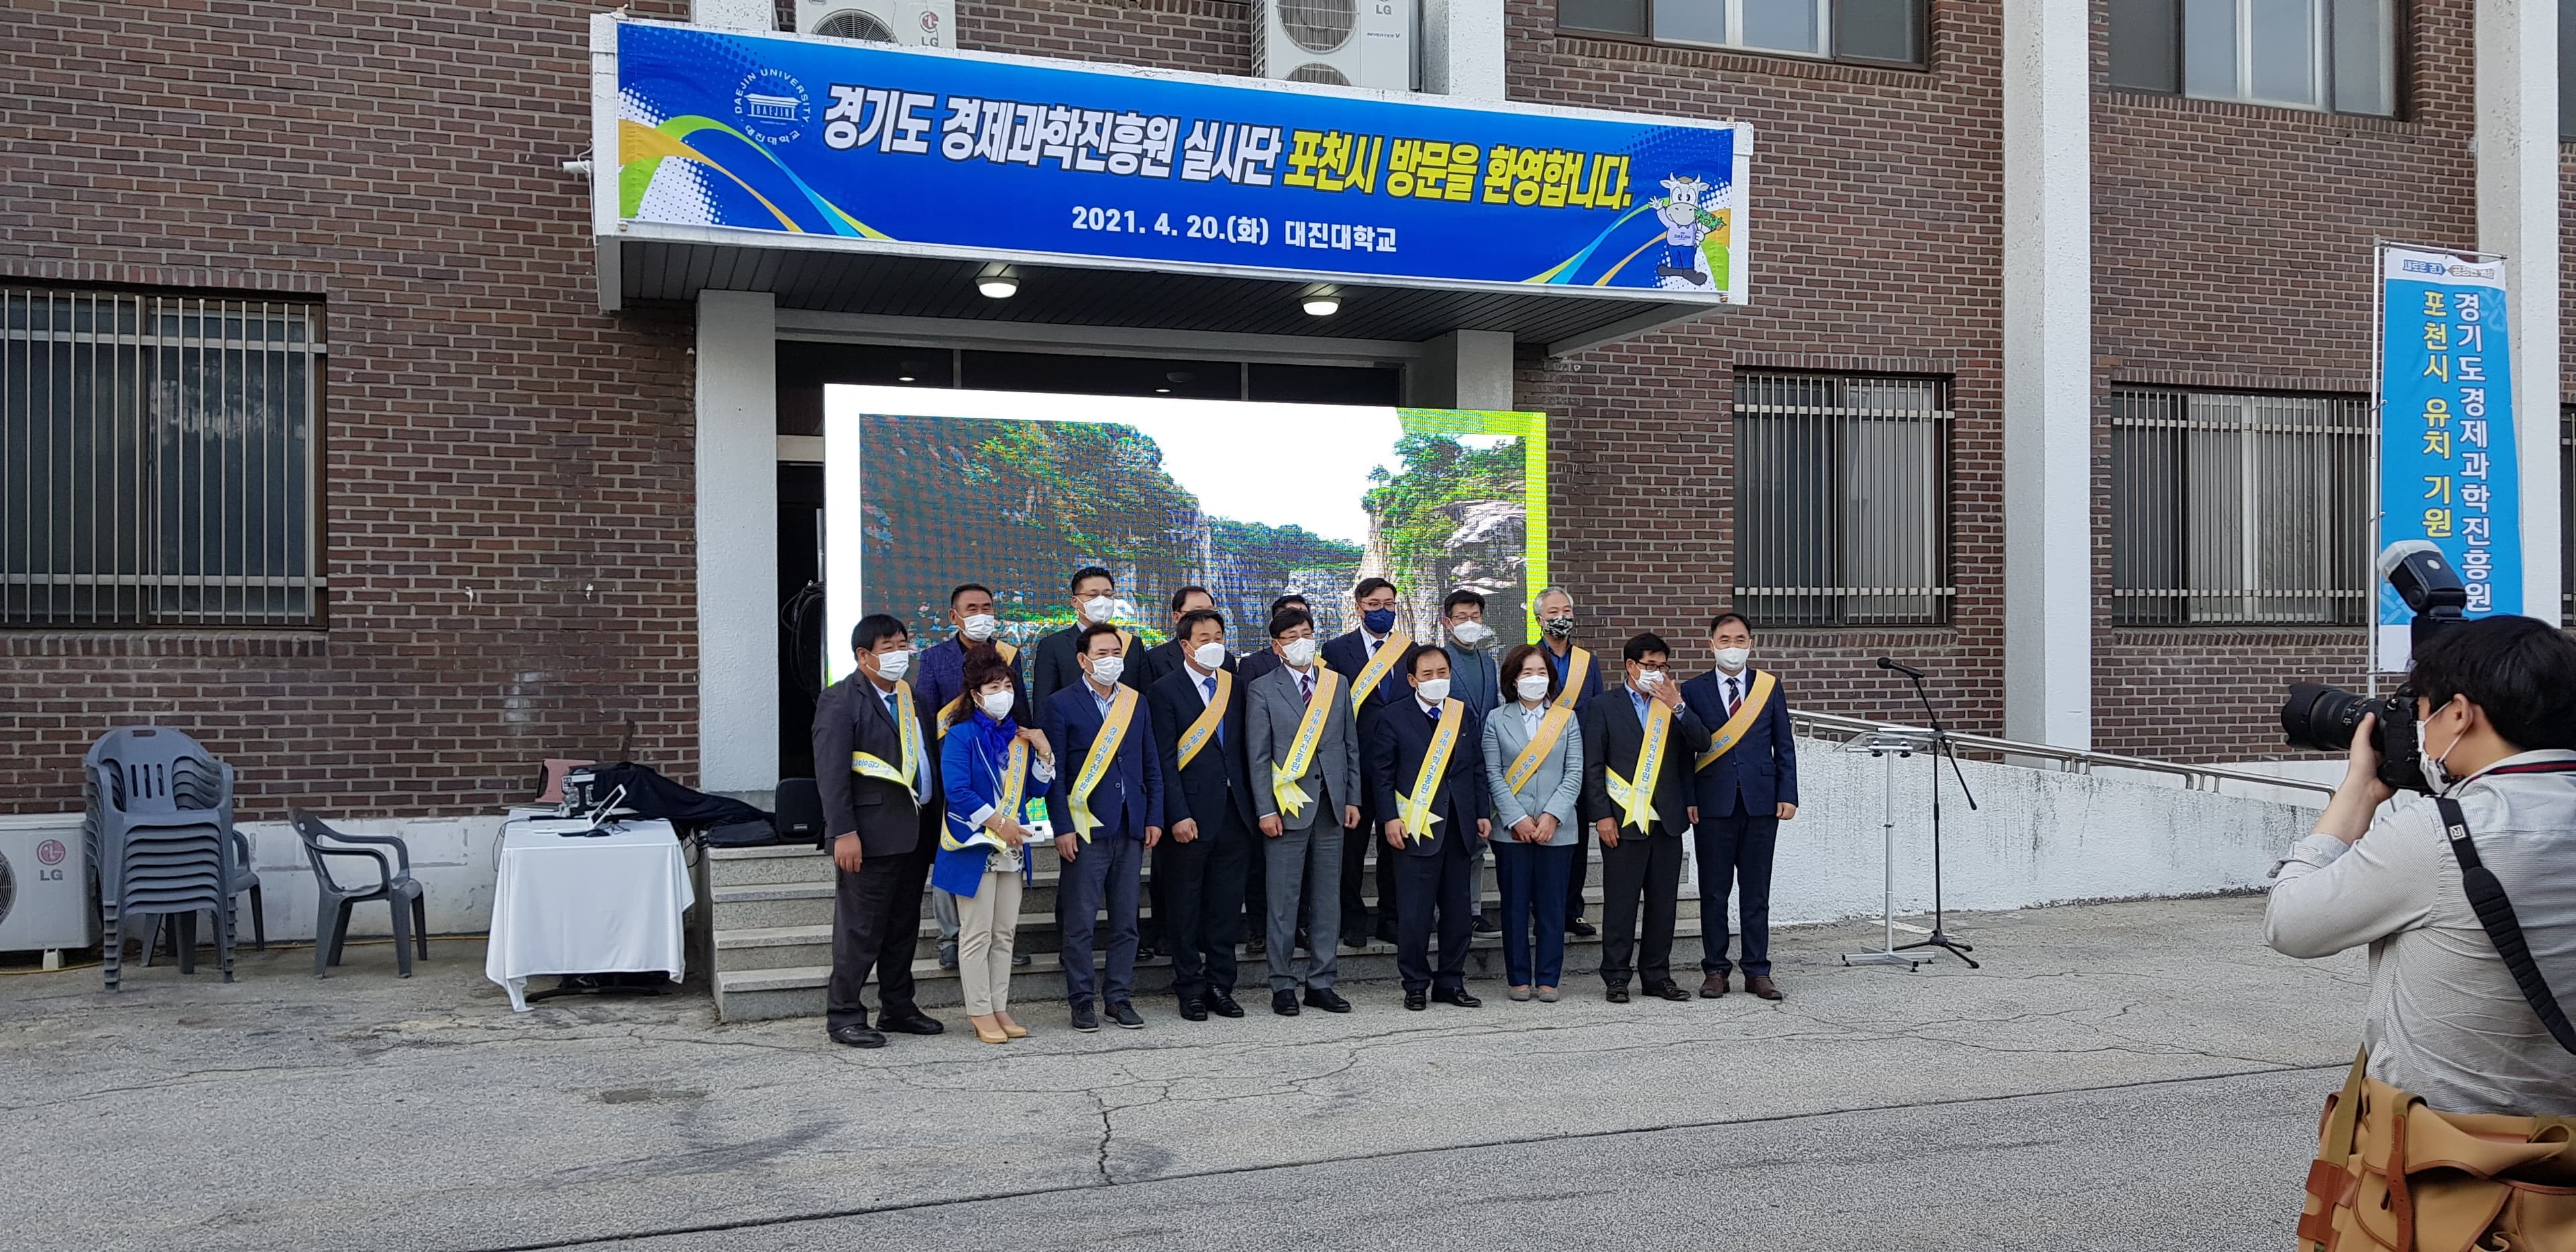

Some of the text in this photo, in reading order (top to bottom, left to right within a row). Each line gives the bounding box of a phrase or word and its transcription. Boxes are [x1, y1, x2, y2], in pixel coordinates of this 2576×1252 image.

[1376, 4, 1392, 15] LG
[921, 36, 938, 47] LG
[734, 68, 811, 123] DAEJIN UNIVERSITY
[756, 105, 790, 118] DAEJIN
[745, 124, 800, 146] 대진대학교
[824, 84, 1634, 211] 경기도 경제과학진흥원 실사단 포천시 방문을 환영합니다.
[1072, 206, 1397, 252] 2021. 4. 20.(화) 대진대학교
[2422, 290, 2453, 537] 포천시 유치 기원
[2453, 293, 2492, 612] 경기도경제과학진흥원
[1078, 725, 1119, 793] 경제과학진흥원
[1291, 707, 1323, 774] 경제과학진흥원
[1421, 729, 1451, 795] 경제과학진흥원
[1642, 718, 1663, 783] 경제과학진흥원
[40, 869, 63, 880] LG
